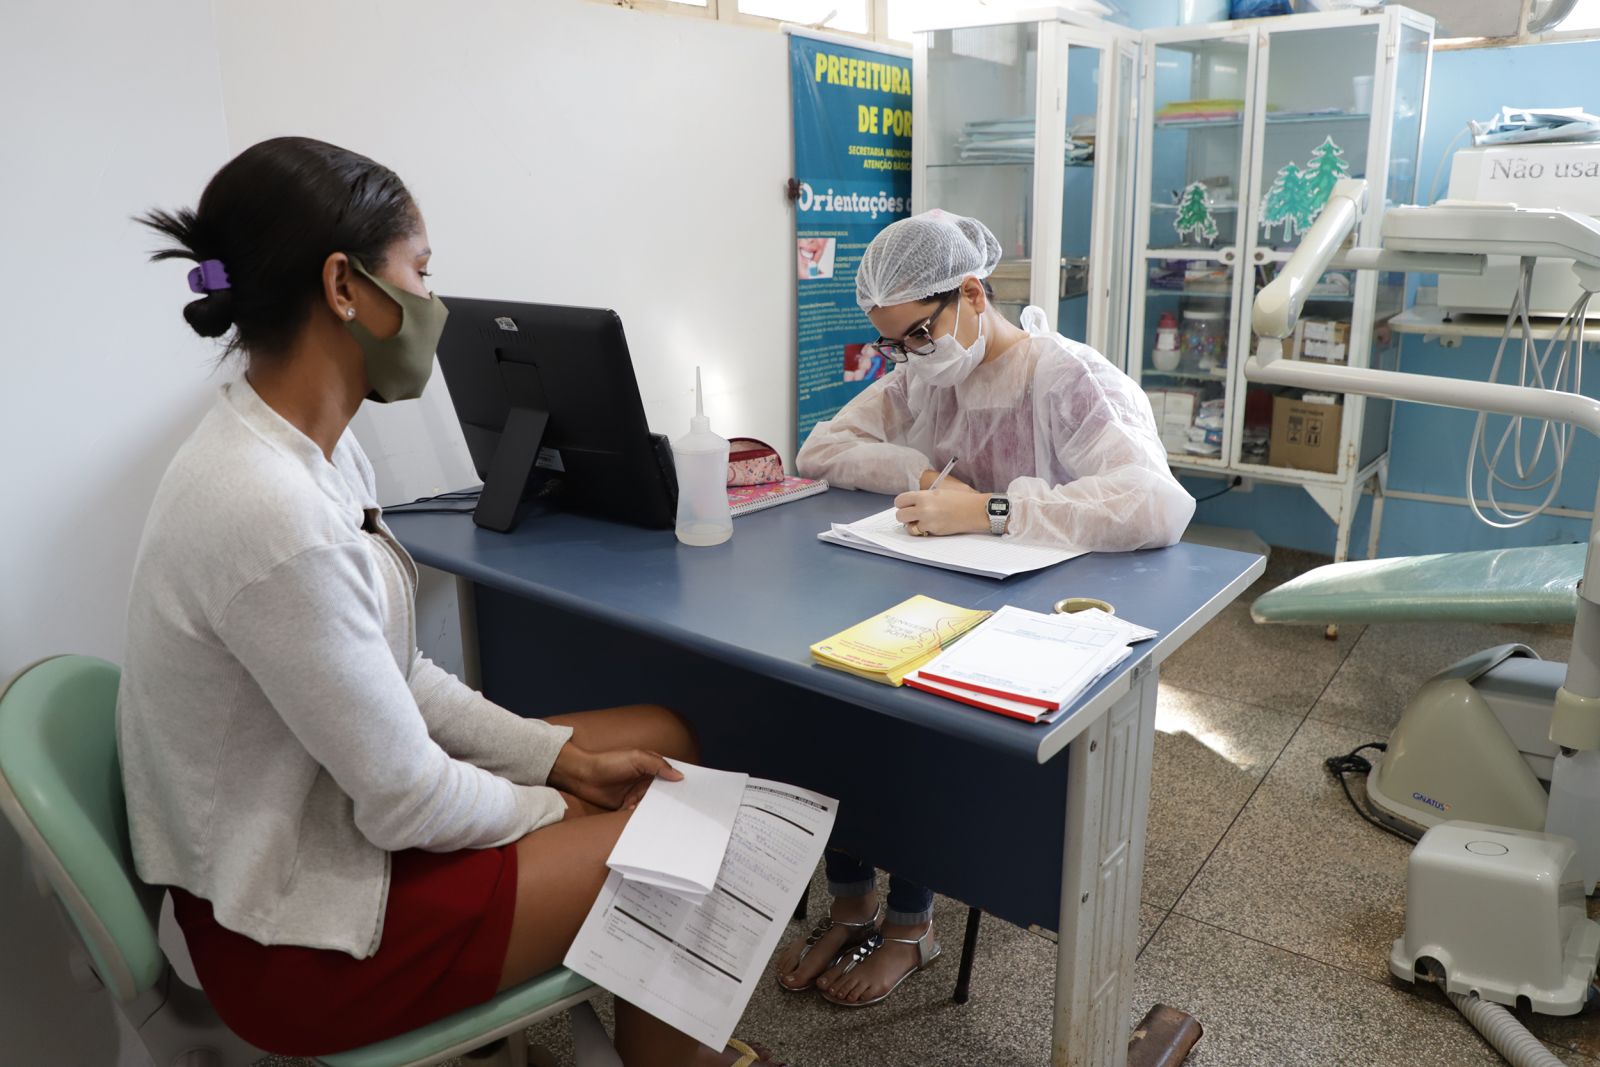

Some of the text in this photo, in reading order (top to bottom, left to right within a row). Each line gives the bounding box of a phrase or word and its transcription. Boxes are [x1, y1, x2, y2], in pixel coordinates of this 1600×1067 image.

[815, 52, 911, 95] PREFEITURA
[857, 104, 879, 135] DE
[848, 145, 884, 157] SECRETARIA
[863, 158, 893, 172] ATENÇÃO
[1489, 157, 1545, 180] Não
[798, 182, 904, 219] Orientações
[1412, 792, 1445, 812] GNATUS
